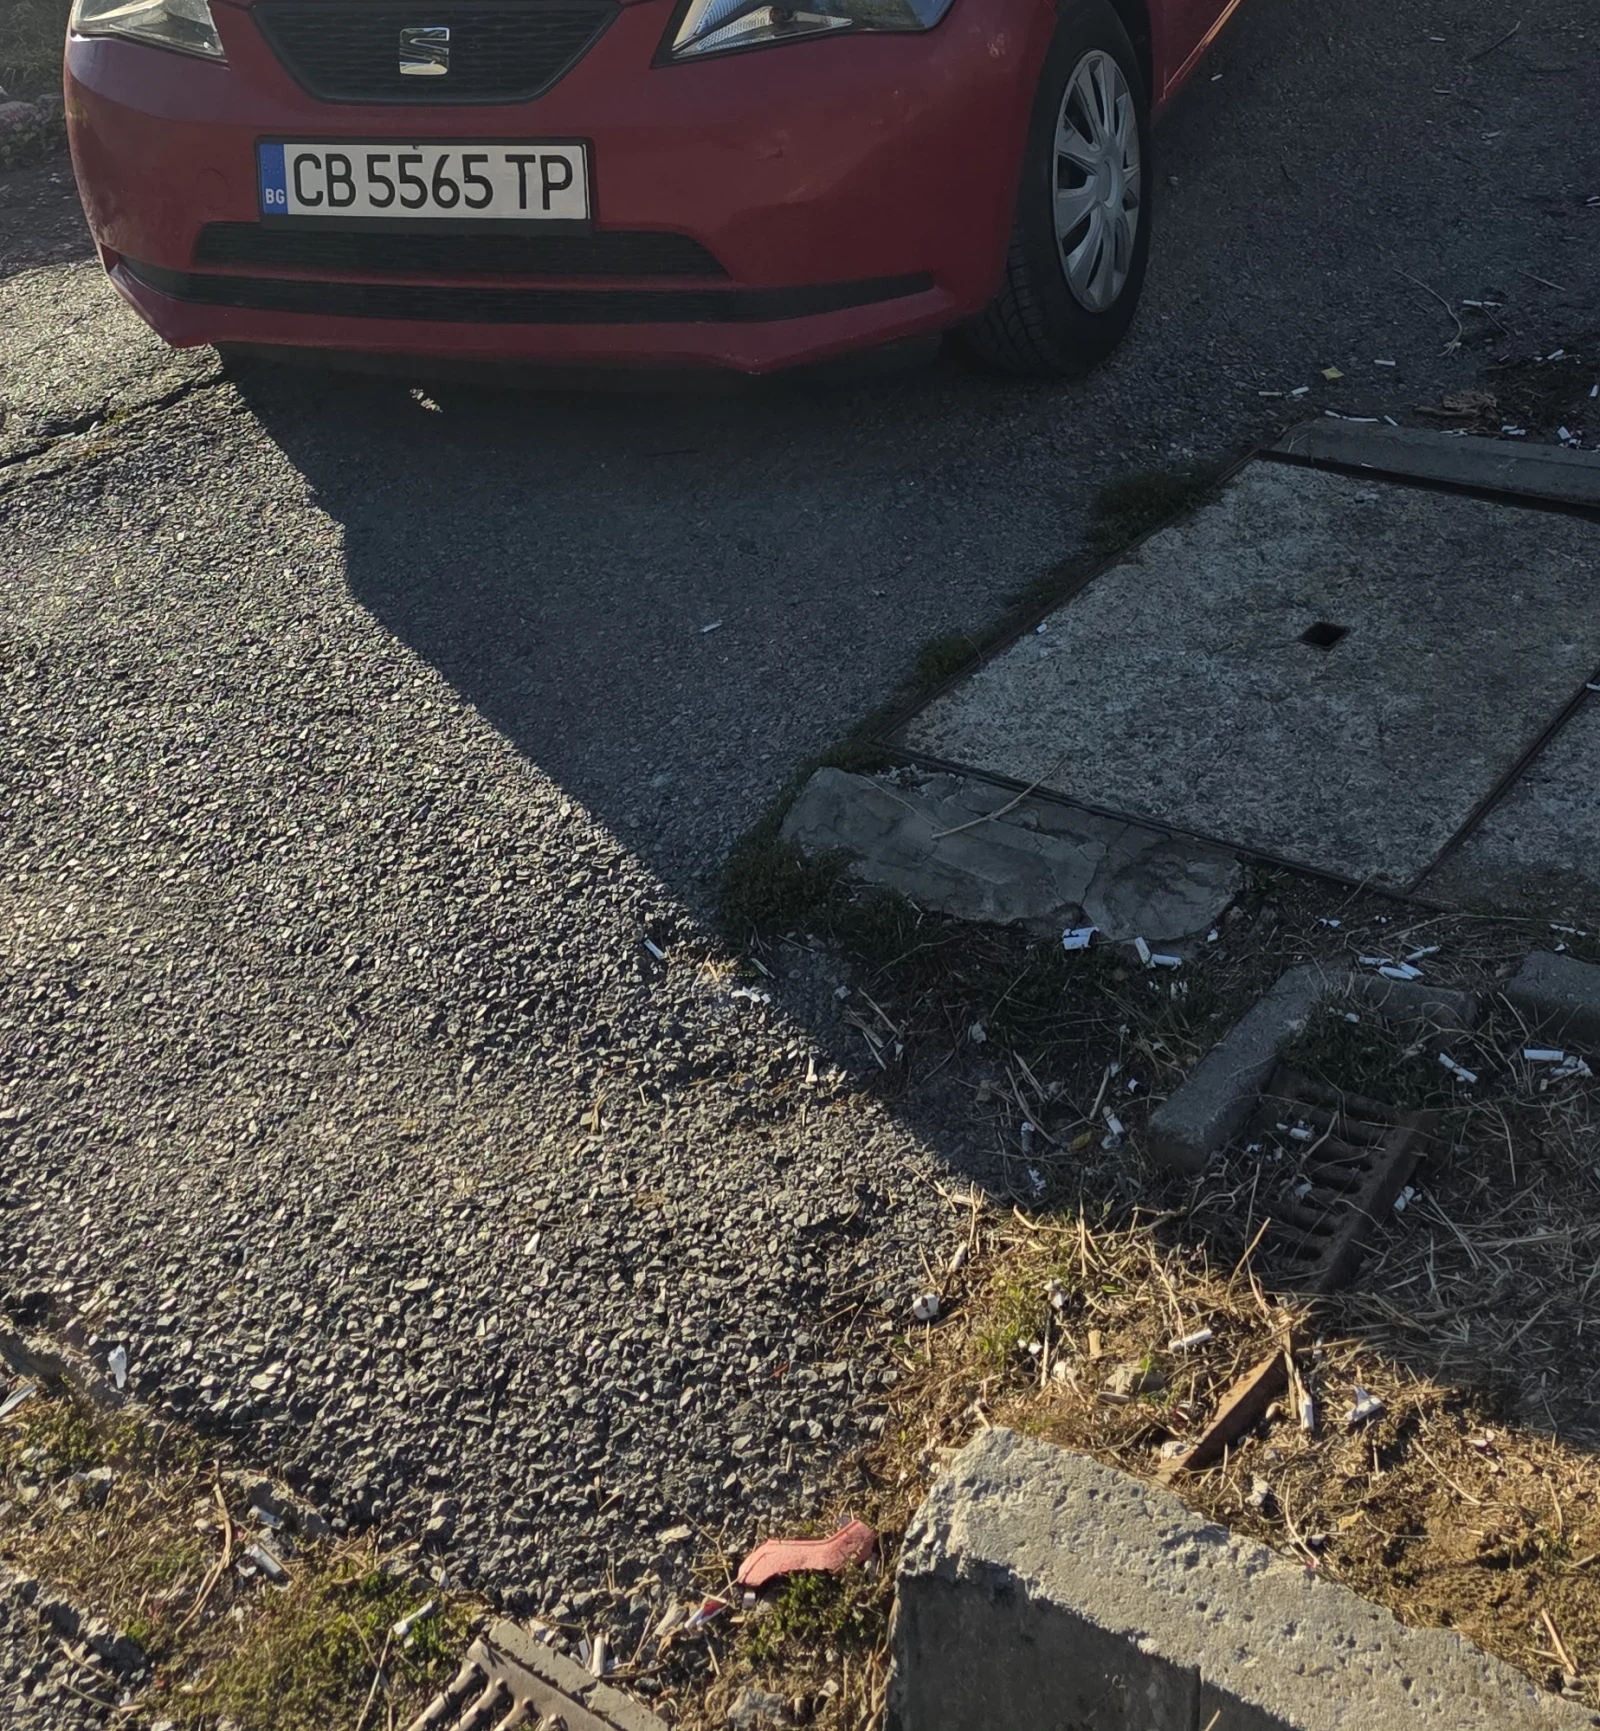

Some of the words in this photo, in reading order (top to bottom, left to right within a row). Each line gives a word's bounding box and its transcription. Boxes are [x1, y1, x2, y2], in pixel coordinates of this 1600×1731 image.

[265, 188, 286, 205] BG
[293, 153, 356, 207] CB
[366, 154, 494, 210] 5565
[505, 154, 573, 210] TP
